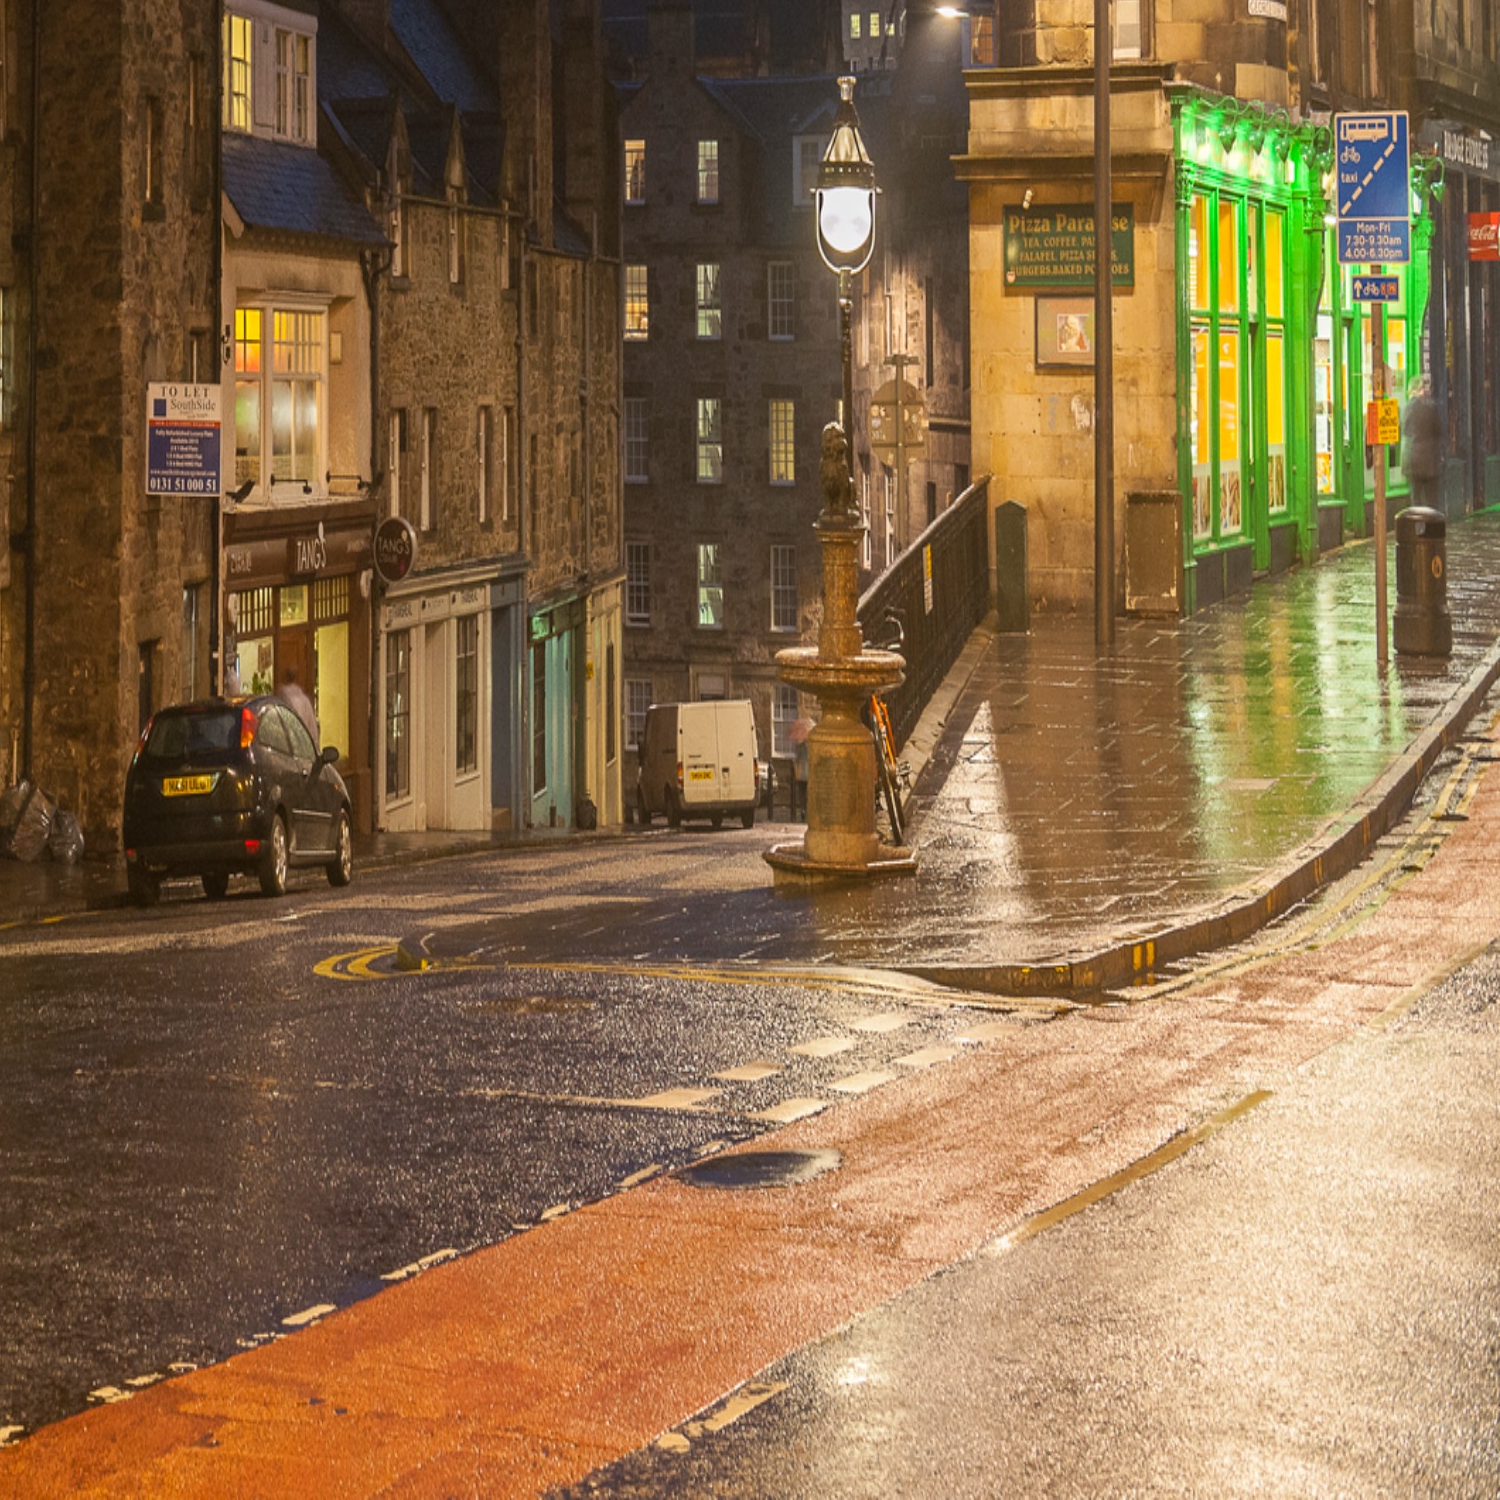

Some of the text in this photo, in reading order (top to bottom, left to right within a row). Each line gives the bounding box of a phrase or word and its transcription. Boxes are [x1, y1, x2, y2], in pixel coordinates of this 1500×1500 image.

[1341, 171, 1358, 184] taxi
[1009, 213, 1129, 234] Pizza Parase
[1356, 222, 1391, 233] Mon-Fri
[161, 386, 210, 398] TO LET
[170, 399, 216, 411] SouthSide
[150, 477, 217, 492] 0131 51 000 51
